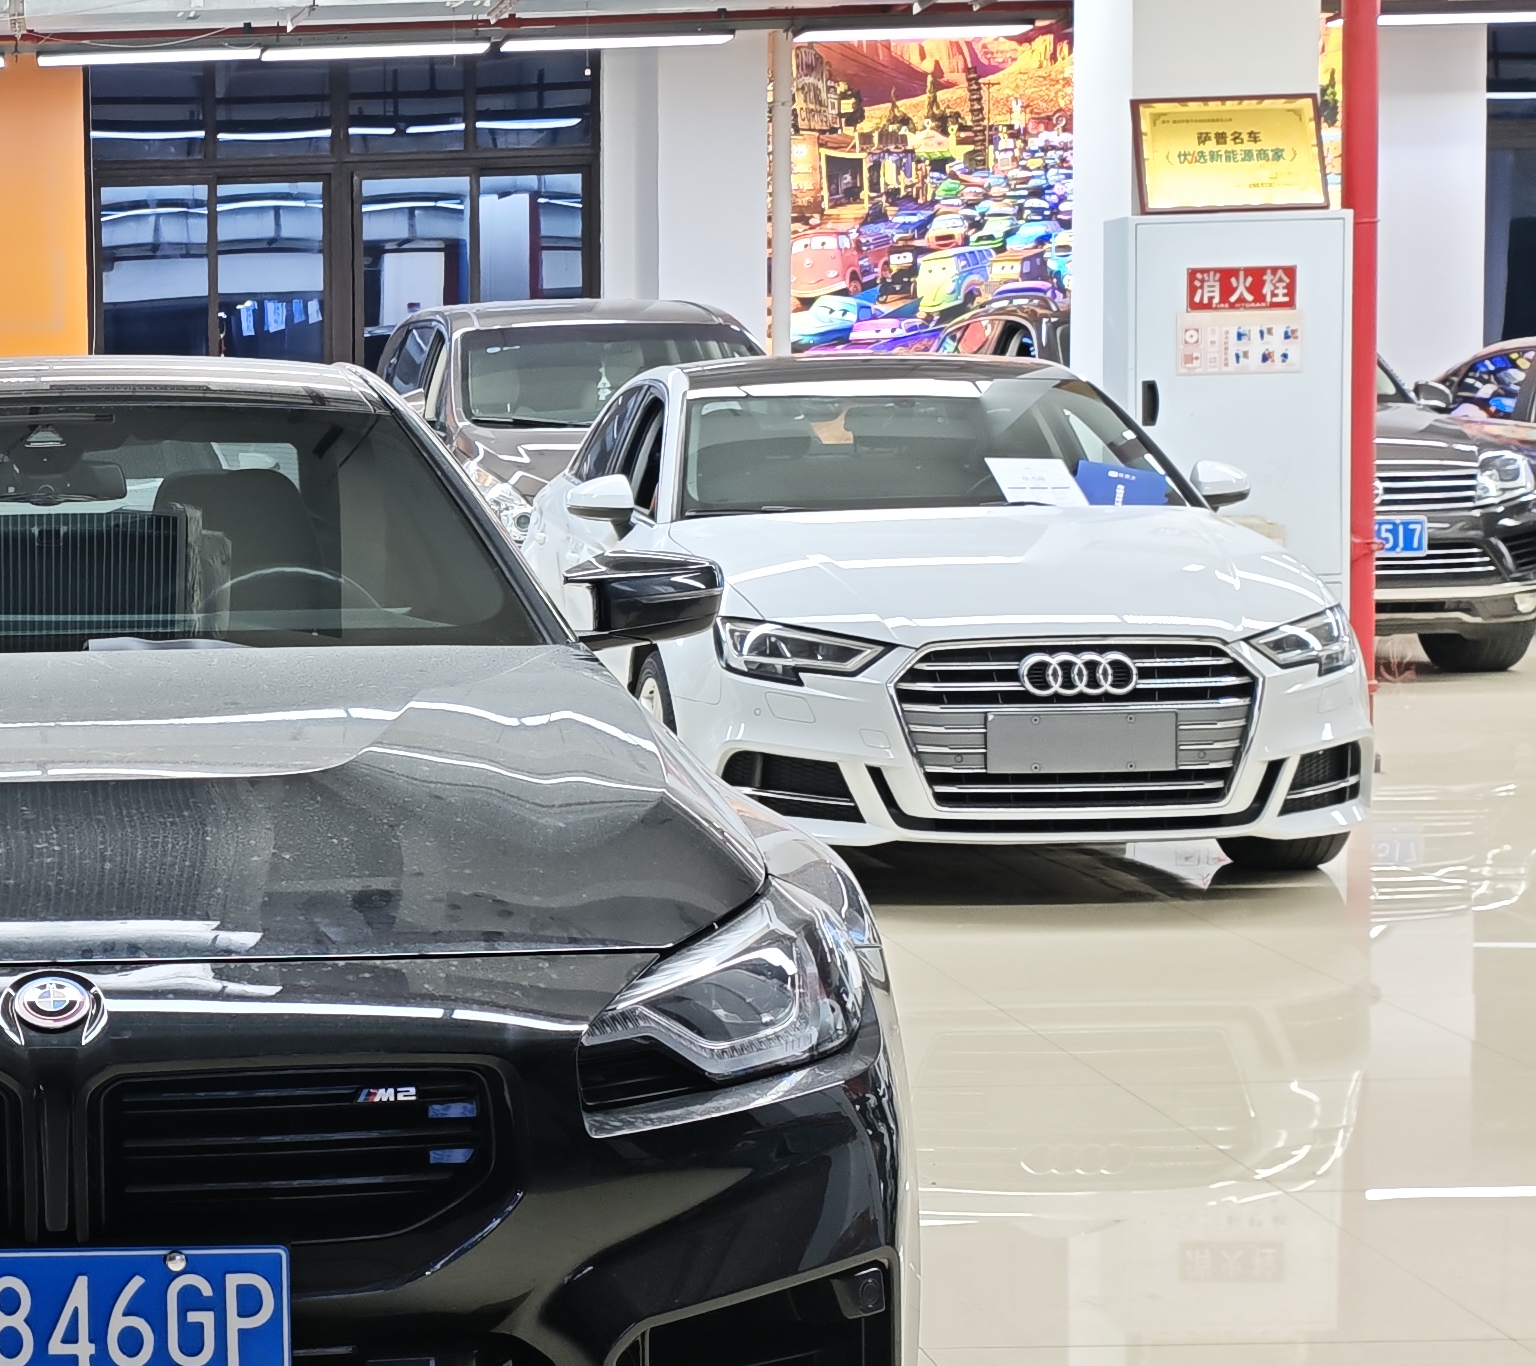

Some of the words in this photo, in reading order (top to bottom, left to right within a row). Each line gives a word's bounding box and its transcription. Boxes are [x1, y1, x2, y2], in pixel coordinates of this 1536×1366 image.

[1196, 130, 1263, 147] 萨普名车
[1193, 269, 1291, 304] 消火栓
[366, 1086, 417, 1103] M2
